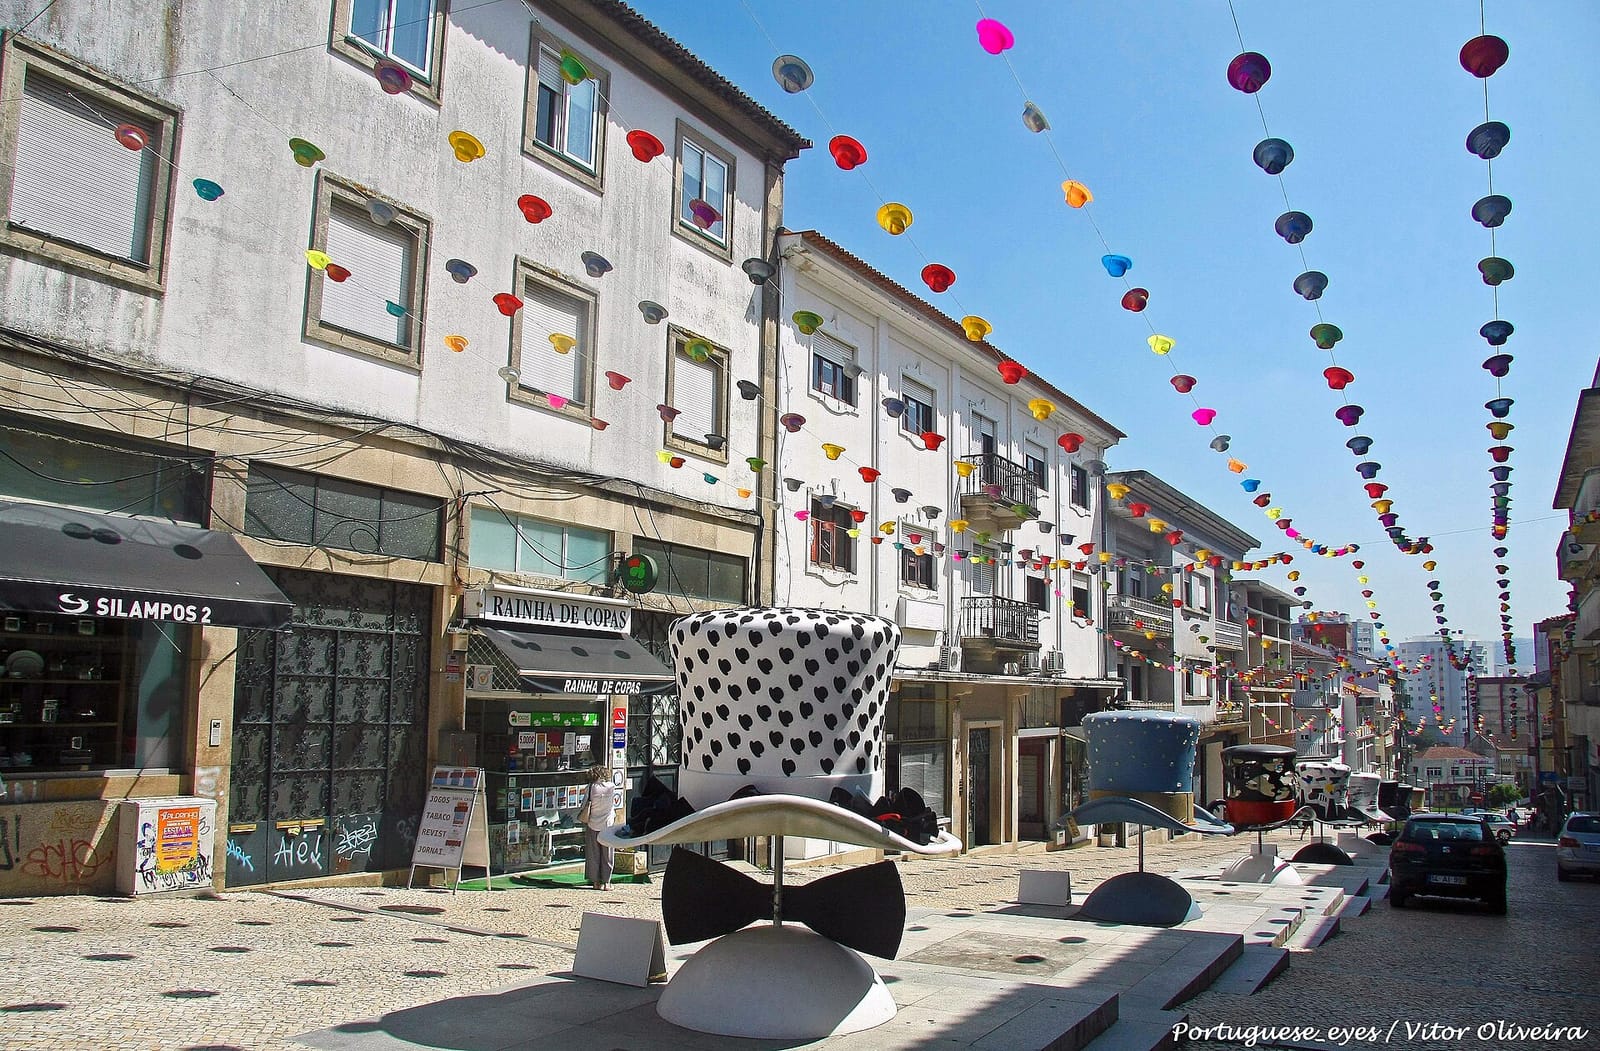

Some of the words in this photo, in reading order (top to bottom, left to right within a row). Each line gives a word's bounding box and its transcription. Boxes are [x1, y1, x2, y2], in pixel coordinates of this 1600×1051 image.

[96, 597, 198, 623] SILAMPOS
[202, 606, 212, 624] 2
[493, 595, 555, 622] RAINHA
[560, 604, 580, 624] DE
[584, 606, 627, 629] COPAS
[563, 679, 598, 694] RAINHA
[601, 681, 614, 694] DE
[614, 682, 641, 694] COPAS
[429, 795, 450, 804] JOGOS
[426, 812, 451, 821] TABACO
[418, 846, 447, 856] JORNAI
